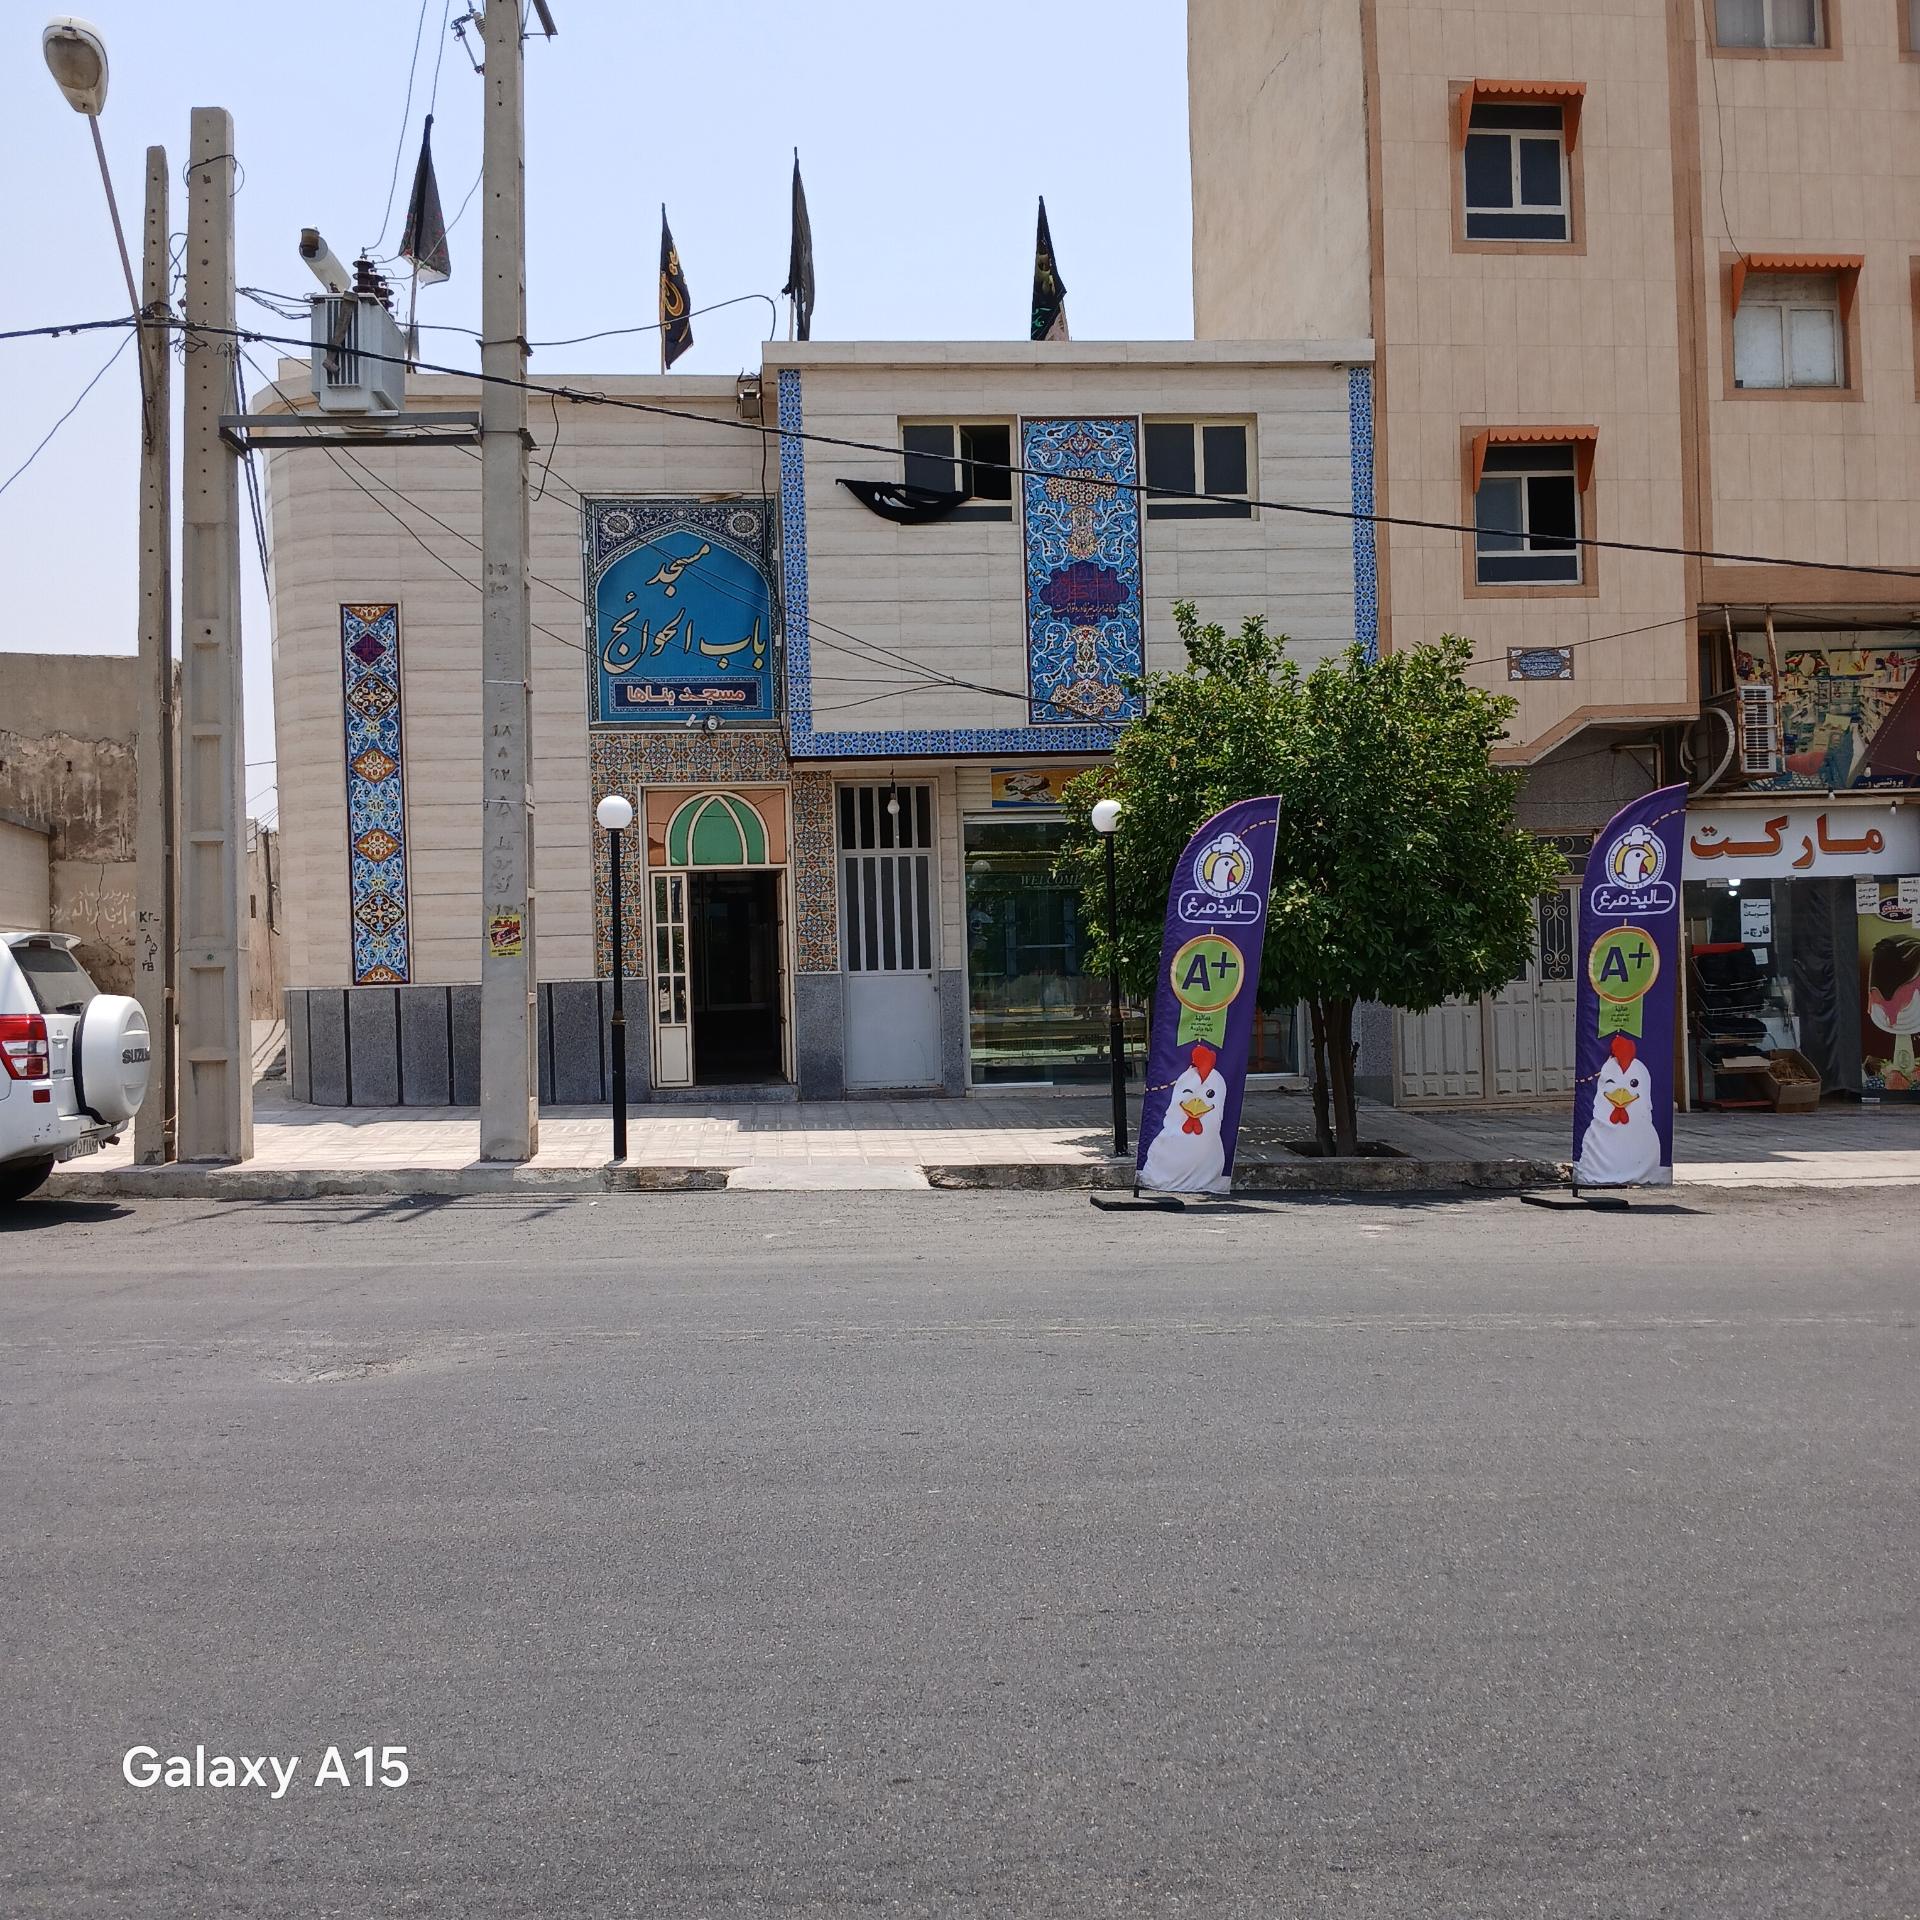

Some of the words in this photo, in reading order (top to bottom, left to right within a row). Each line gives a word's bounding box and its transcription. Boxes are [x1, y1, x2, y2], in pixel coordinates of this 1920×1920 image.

[645, 543, 711, 598] مسجد
[699, 616, 767, 670] باب
[626, 684, 676, 705] بناها
[678, 684, 746, 706] مسجد
[1690, 813, 1886, 869] مارکت
[1020, 875, 1082, 886] WELCOME
[1182, 952, 1237, 991] A+
[1600, 942, 1651, 982] A+
